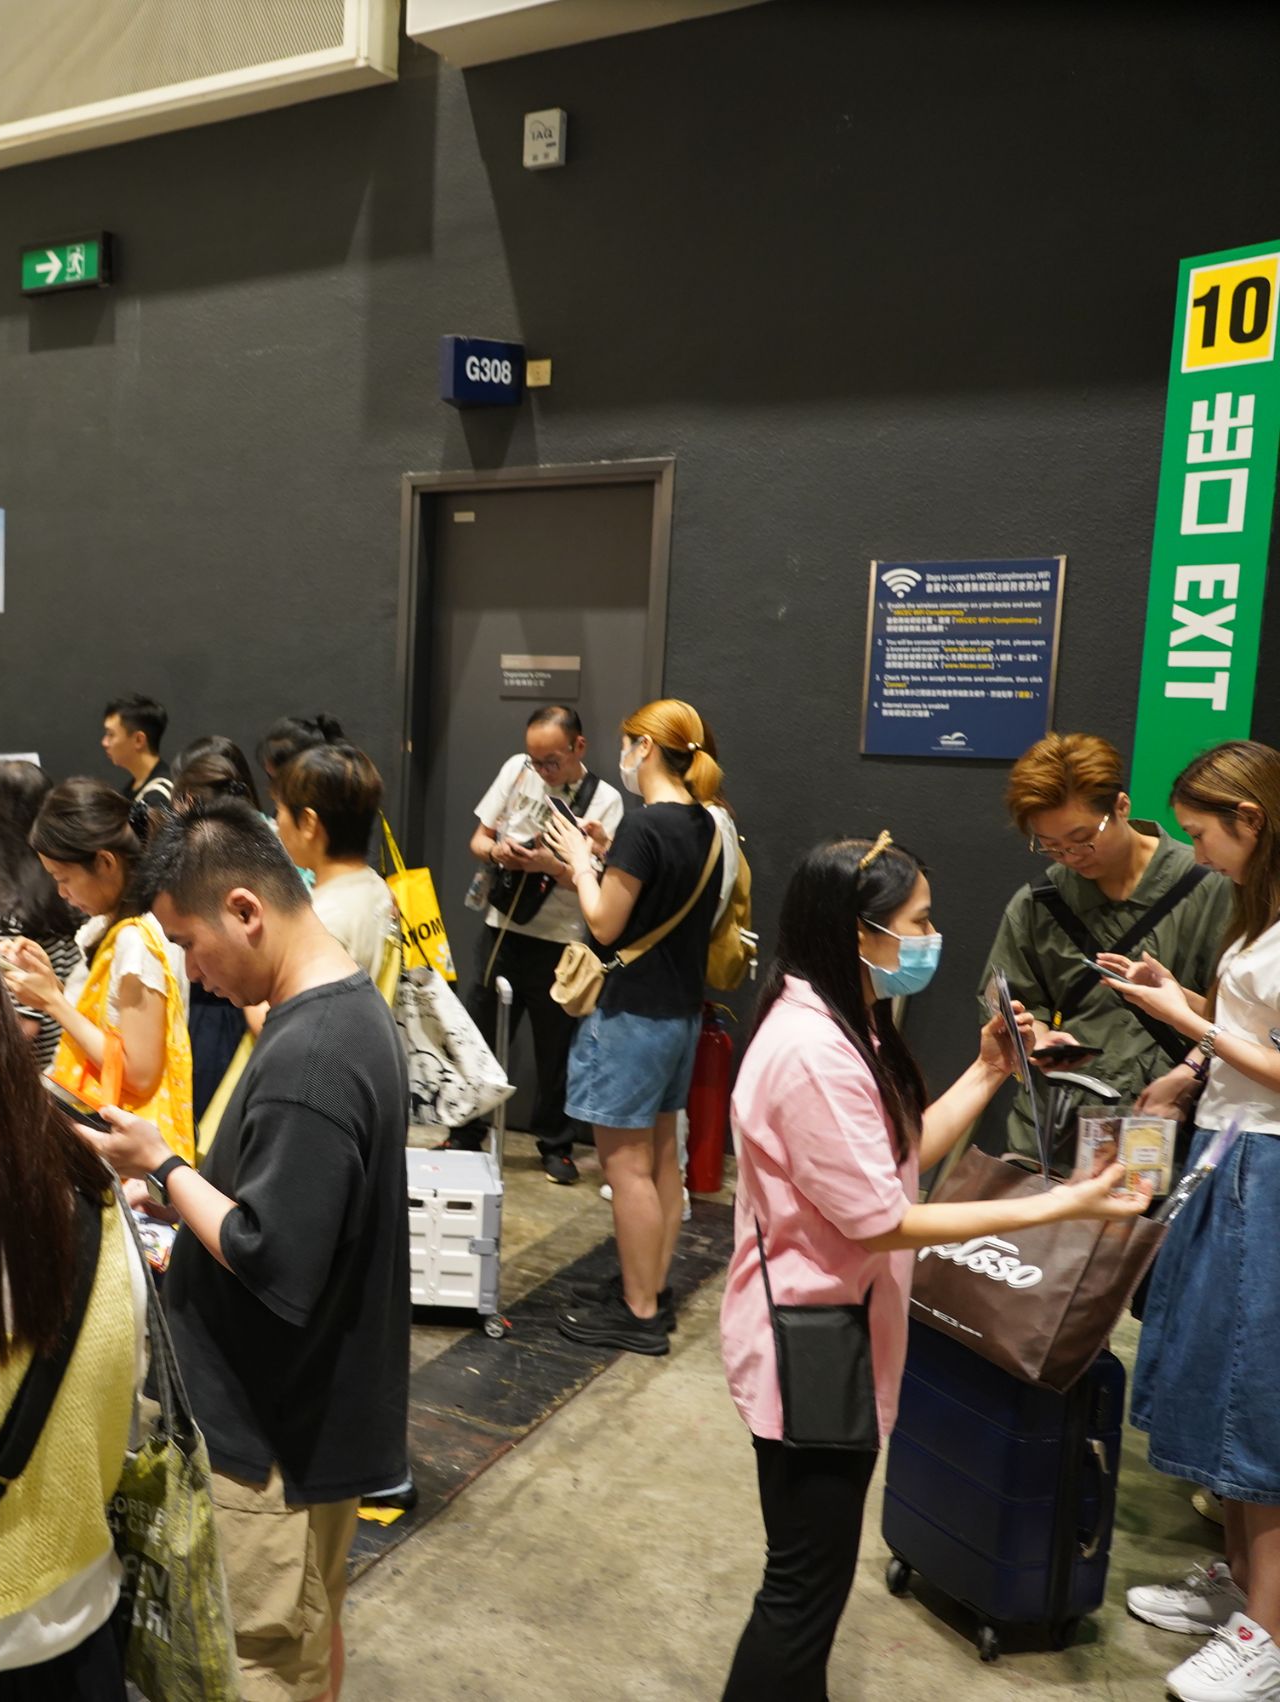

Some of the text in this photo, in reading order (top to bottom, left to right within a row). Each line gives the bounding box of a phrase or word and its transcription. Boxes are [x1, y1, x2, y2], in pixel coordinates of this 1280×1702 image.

[1193, 276, 1271, 349] 10
[465, 355, 512, 385] G308
[1180, 392, 1256, 535] 出口
[1164, 563, 1241, 711] EXIT
